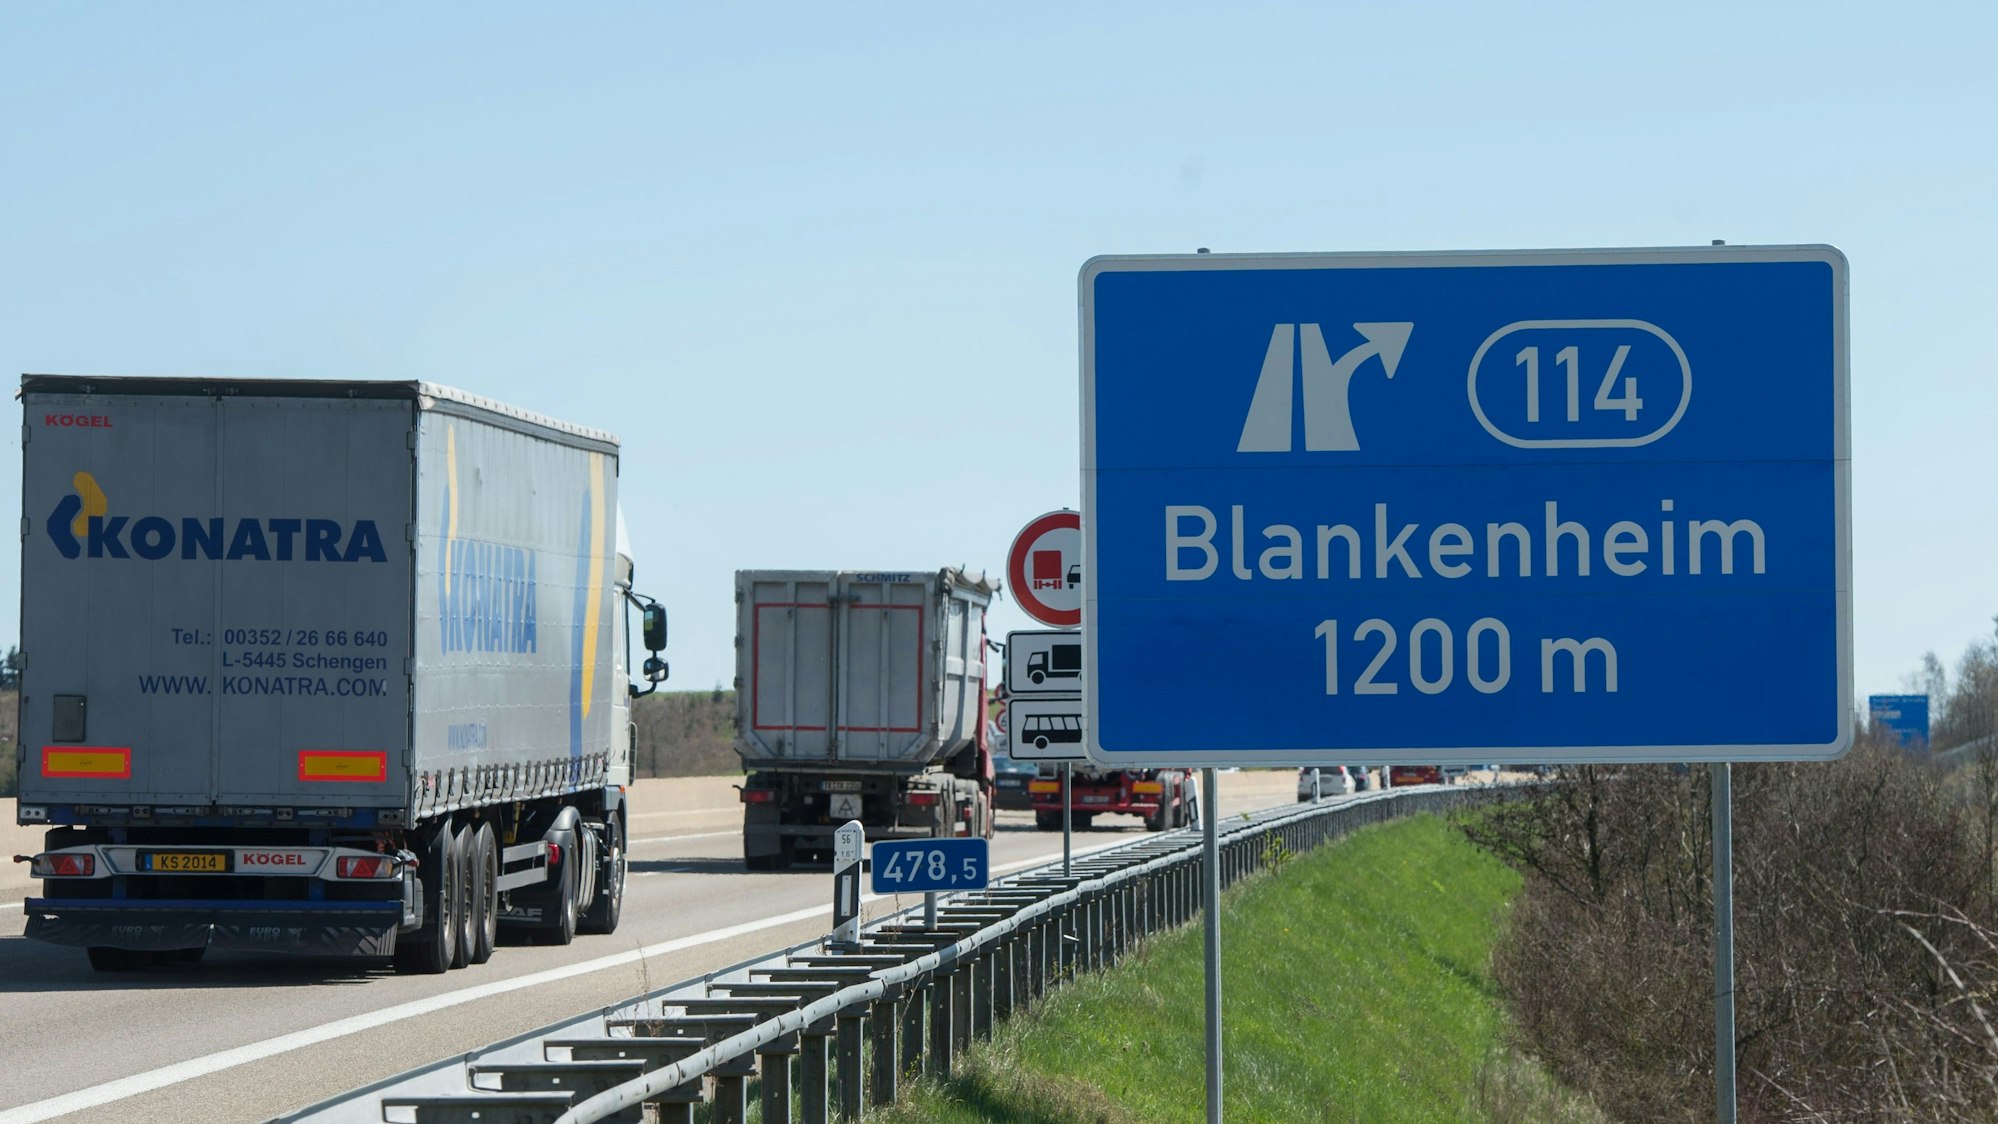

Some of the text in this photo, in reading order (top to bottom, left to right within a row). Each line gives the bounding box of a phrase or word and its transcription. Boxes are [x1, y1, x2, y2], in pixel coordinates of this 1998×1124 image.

[1515, 344, 1644, 423] 114
[45, 414, 113, 428] KÖGEL
[87, 515, 388, 562] KONATRA
[1164, 499, 1767, 582] Blankenheim
[856, 572, 911, 583] SCHMITZ
[449, 538, 537, 654] KONATRA
[171, 628, 212, 645] Tel.:
[224, 629, 281, 646] 00352
[296, 630, 318, 646] 26
[325, 630, 348, 647] 66
[354, 631, 388, 647] 640
[222, 651, 387, 673] L-5445 Schengen
[1313, 617, 1618, 696] 1200 m
[841, 834, 851, 844] 56
[160, 856, 217, 869] KS 2014
[243, 853, 306, 865] KÖGEL
[249, 926, 281, 935] EURO
